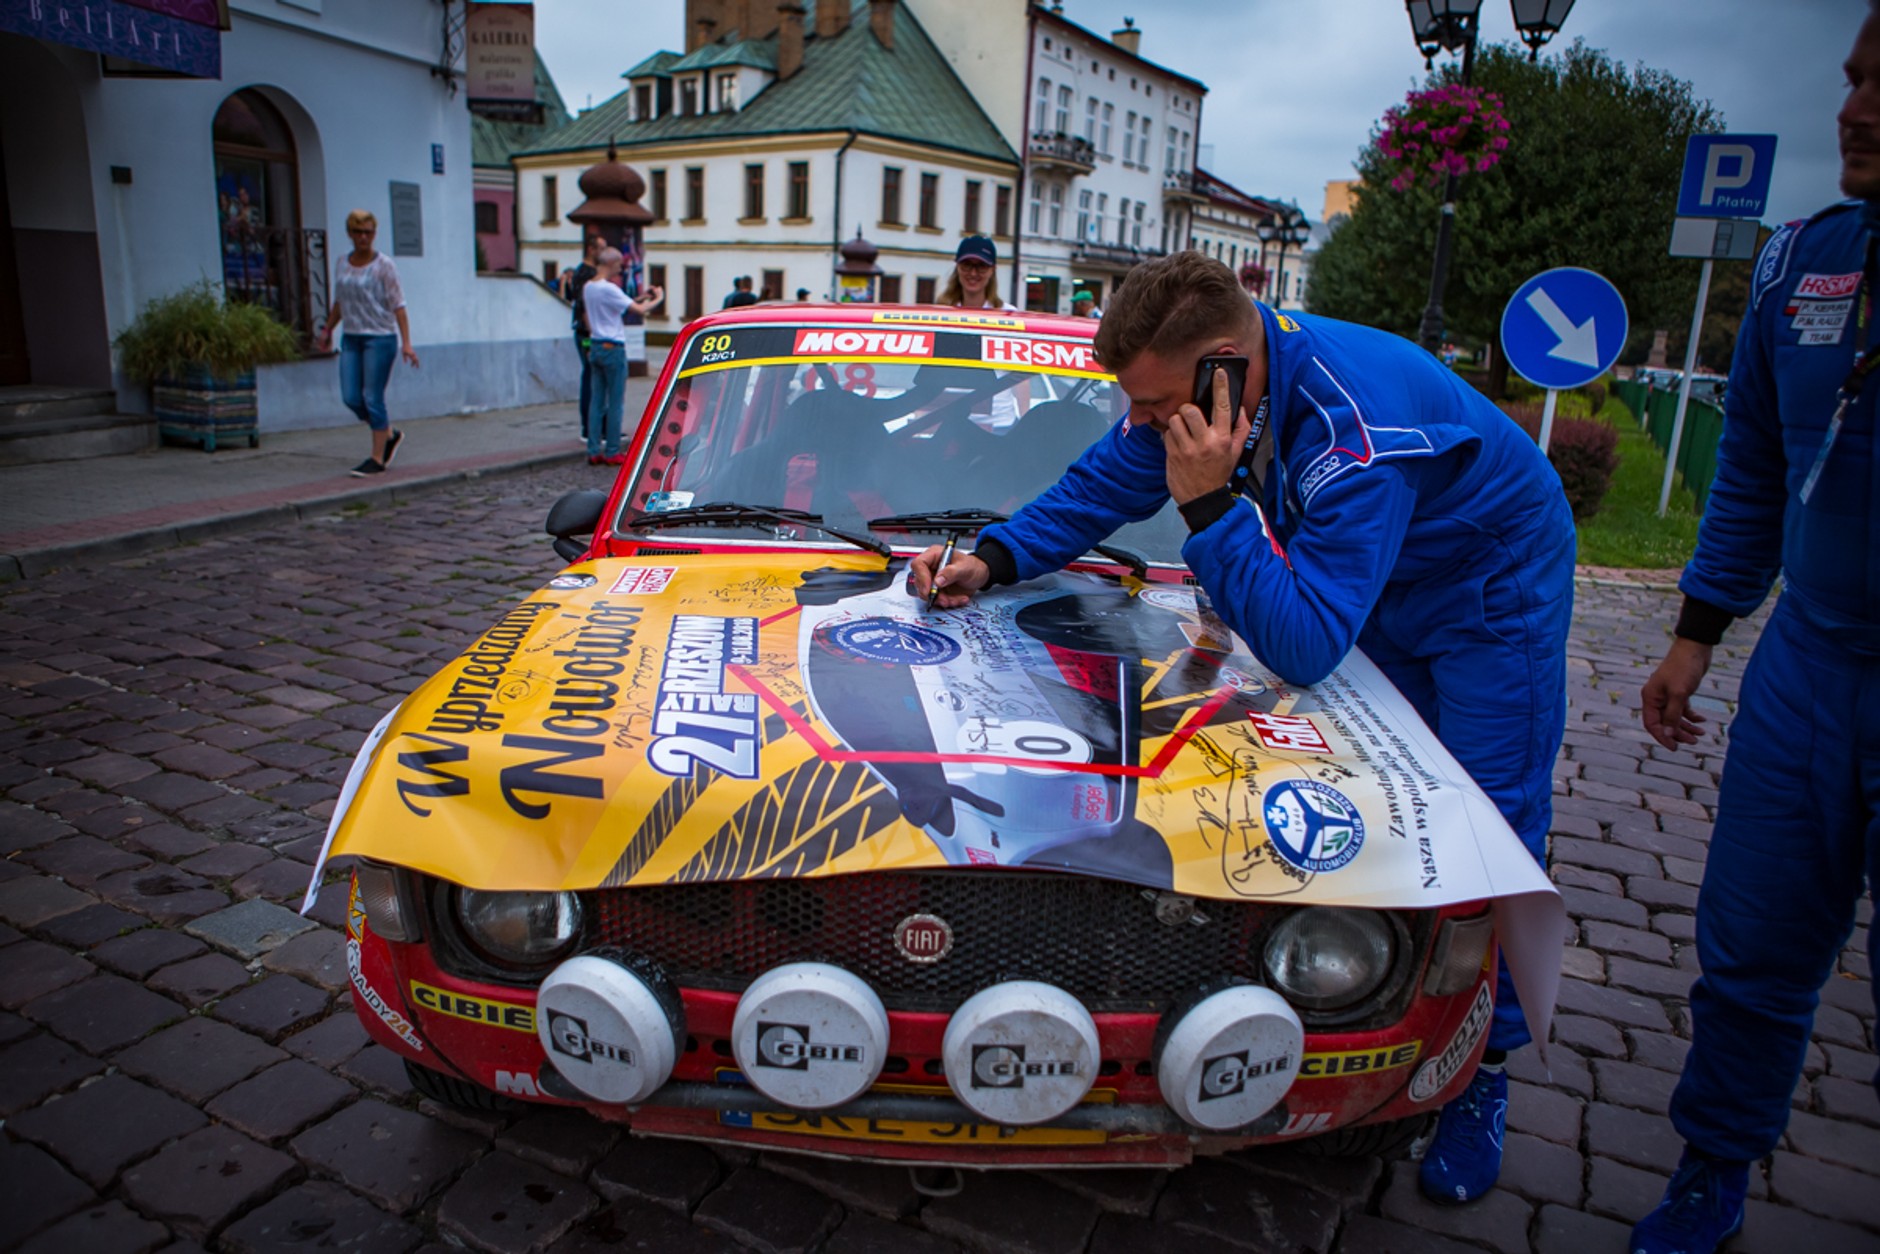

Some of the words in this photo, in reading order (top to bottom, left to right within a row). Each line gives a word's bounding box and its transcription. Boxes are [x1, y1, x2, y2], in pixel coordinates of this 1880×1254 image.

[1700, 144, 1755, 206] P
[701, 335, 732, 354] 80
[702, 351, 736, 363] K2/C1
[797, 331, 930, 355] MOTUL
[1809, 333, 1834, 342] TEAM
[396, 601, 562, 818] Wyprzedzamy
[499, 600, 646, 820] Nowotwór
[663, 694, 757, 712] RALLY
[650, 711, 757, 778] 27
[1250, 713, 1329, 753] Fakt
[1419, 837, 1442, 890] Nasza
[906, 929, 942, 951] FIAT
[1436, 985, 1489, 1079] MOTO
